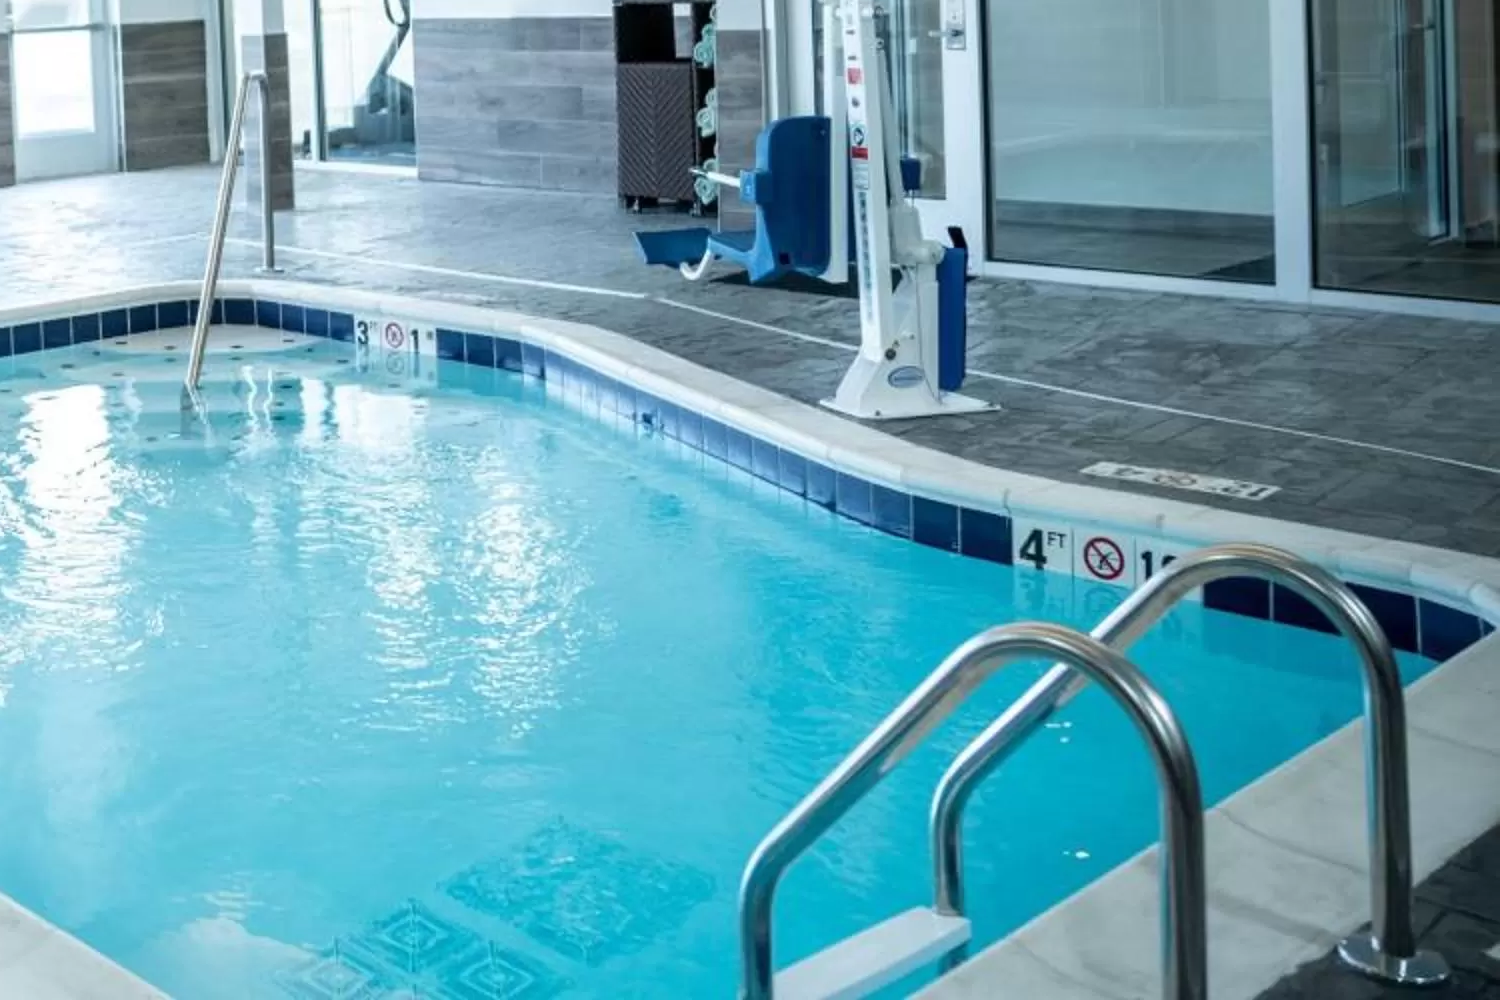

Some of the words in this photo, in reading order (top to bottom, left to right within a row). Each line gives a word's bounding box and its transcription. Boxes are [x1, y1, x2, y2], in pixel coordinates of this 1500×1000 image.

[357, 321, 369, 344] 3
[1019, 529, 1047, 571] 4
[1047, 531, 1067, 549] FT
[1141, 551, 1177, 581] 1
